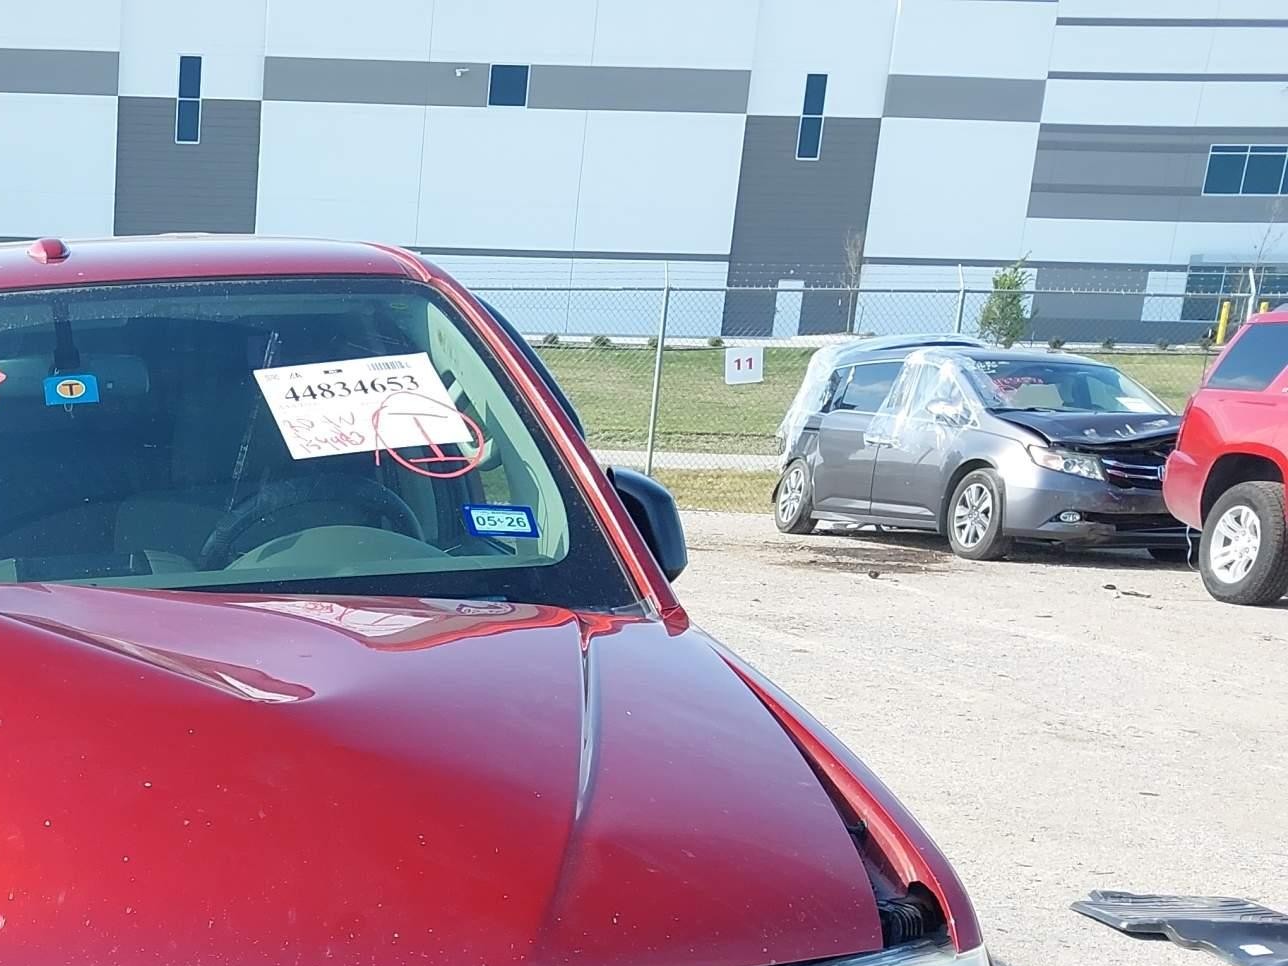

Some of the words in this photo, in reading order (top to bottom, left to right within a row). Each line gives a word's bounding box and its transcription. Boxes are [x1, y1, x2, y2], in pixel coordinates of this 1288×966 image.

[733, 356, 754, 371] 11
[61, 382, 81, 397] T
[284, 375, 420, 402] 44834653
